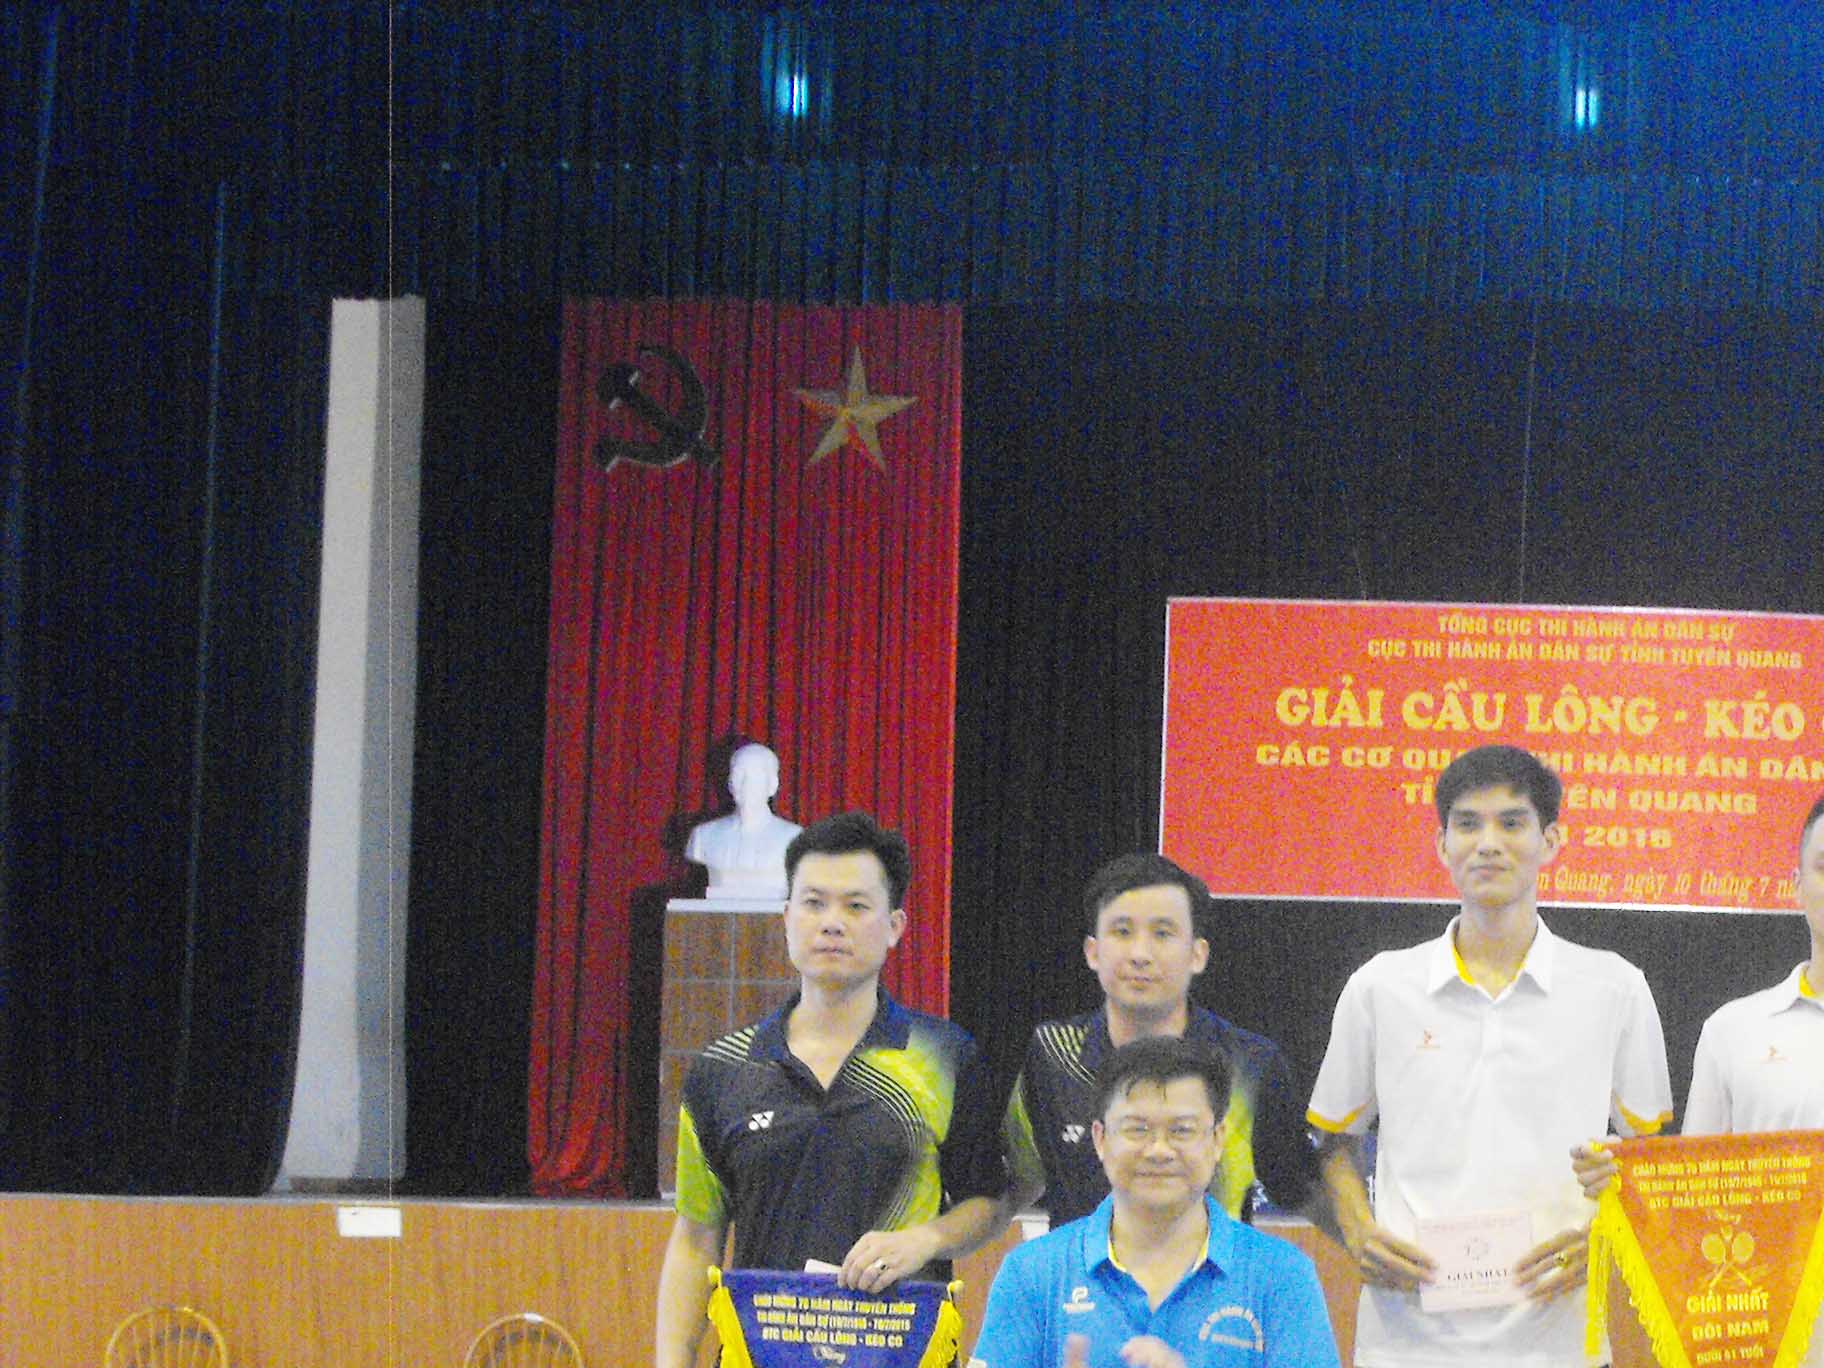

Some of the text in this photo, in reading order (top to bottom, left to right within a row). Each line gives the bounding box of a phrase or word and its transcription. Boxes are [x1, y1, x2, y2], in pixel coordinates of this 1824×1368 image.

[1539, 618, 1568, 636] THI
[1573, 615, 1626, 637] HÀNH
[1664, 618, 1704, 640] DÂN
[1411, 640, 1442, 658] THI
[1447, 638, 1501, 660] HÀNH
[1539, 639, 1580, 661] DÂN
[1736, 650, 1804, 670] QUANG
[1275, 674, 1385, 728] GIẢI
[1402, 677, 1507, 733] CẦU
[1525, 682, 1659, 736] LÔNG
[1705, 690, 1805, 741] KÉO
[1256, 741, 1330, 768] CÁC
[1341, 745, 1395, 768] CƠ
[1402, 748, 1467, 770] QU
[1583, 748, 1690, 777] HÀNH
[1695, 752, 1749, 779] ÁN
[1628, 791, 1757, 816] QUANG
